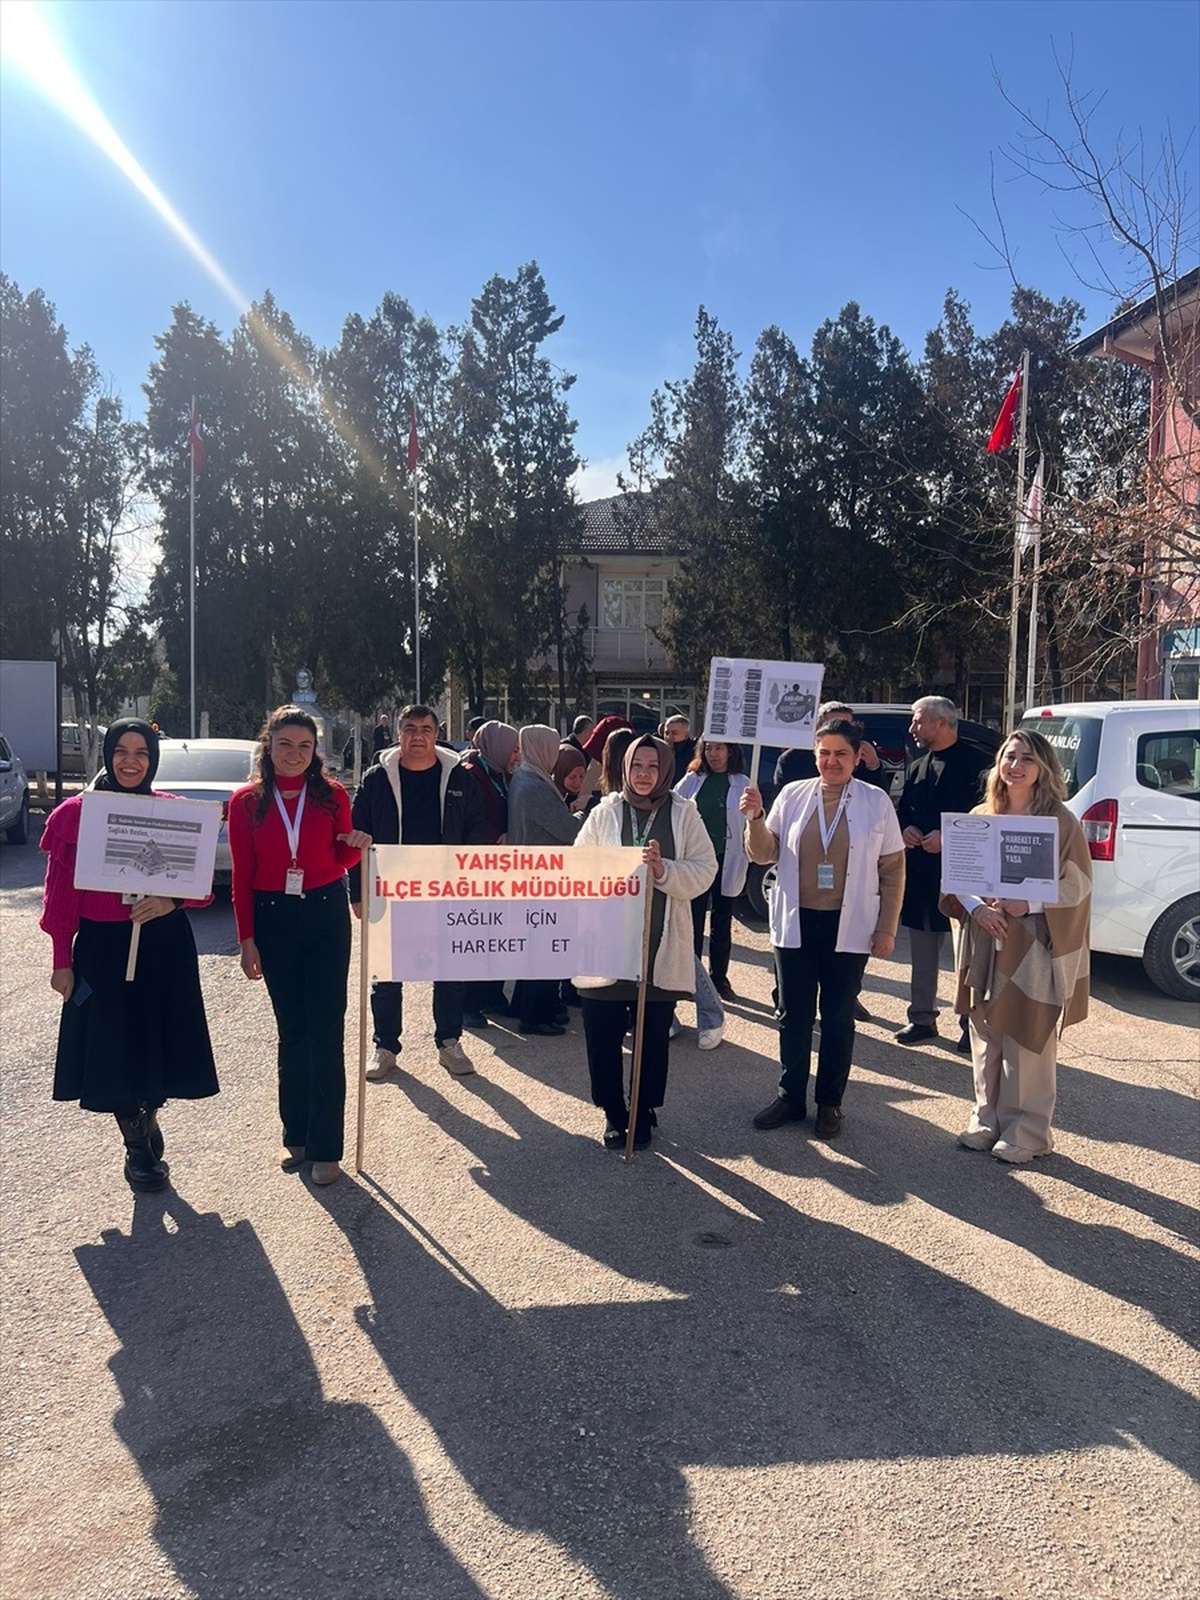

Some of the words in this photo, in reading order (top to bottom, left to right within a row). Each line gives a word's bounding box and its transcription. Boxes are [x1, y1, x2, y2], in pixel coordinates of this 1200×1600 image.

[1005, 835, 1031, 845] HAREKET
[455, 850, 564, 873] YAHŞİHAN
[375, 876, 422, 899] İLÇE
[428, 876, 505, 898] SAĞLIK
[511, 876, 641, 898] MÜDÜRLÜĞÜ
[446, 909, 503, 926] SAĞLIK
[525, 909, 557, 928] İÇİN
[451, 938, 527, 954] HAREKET
[551, 938, 570, 953] ET
